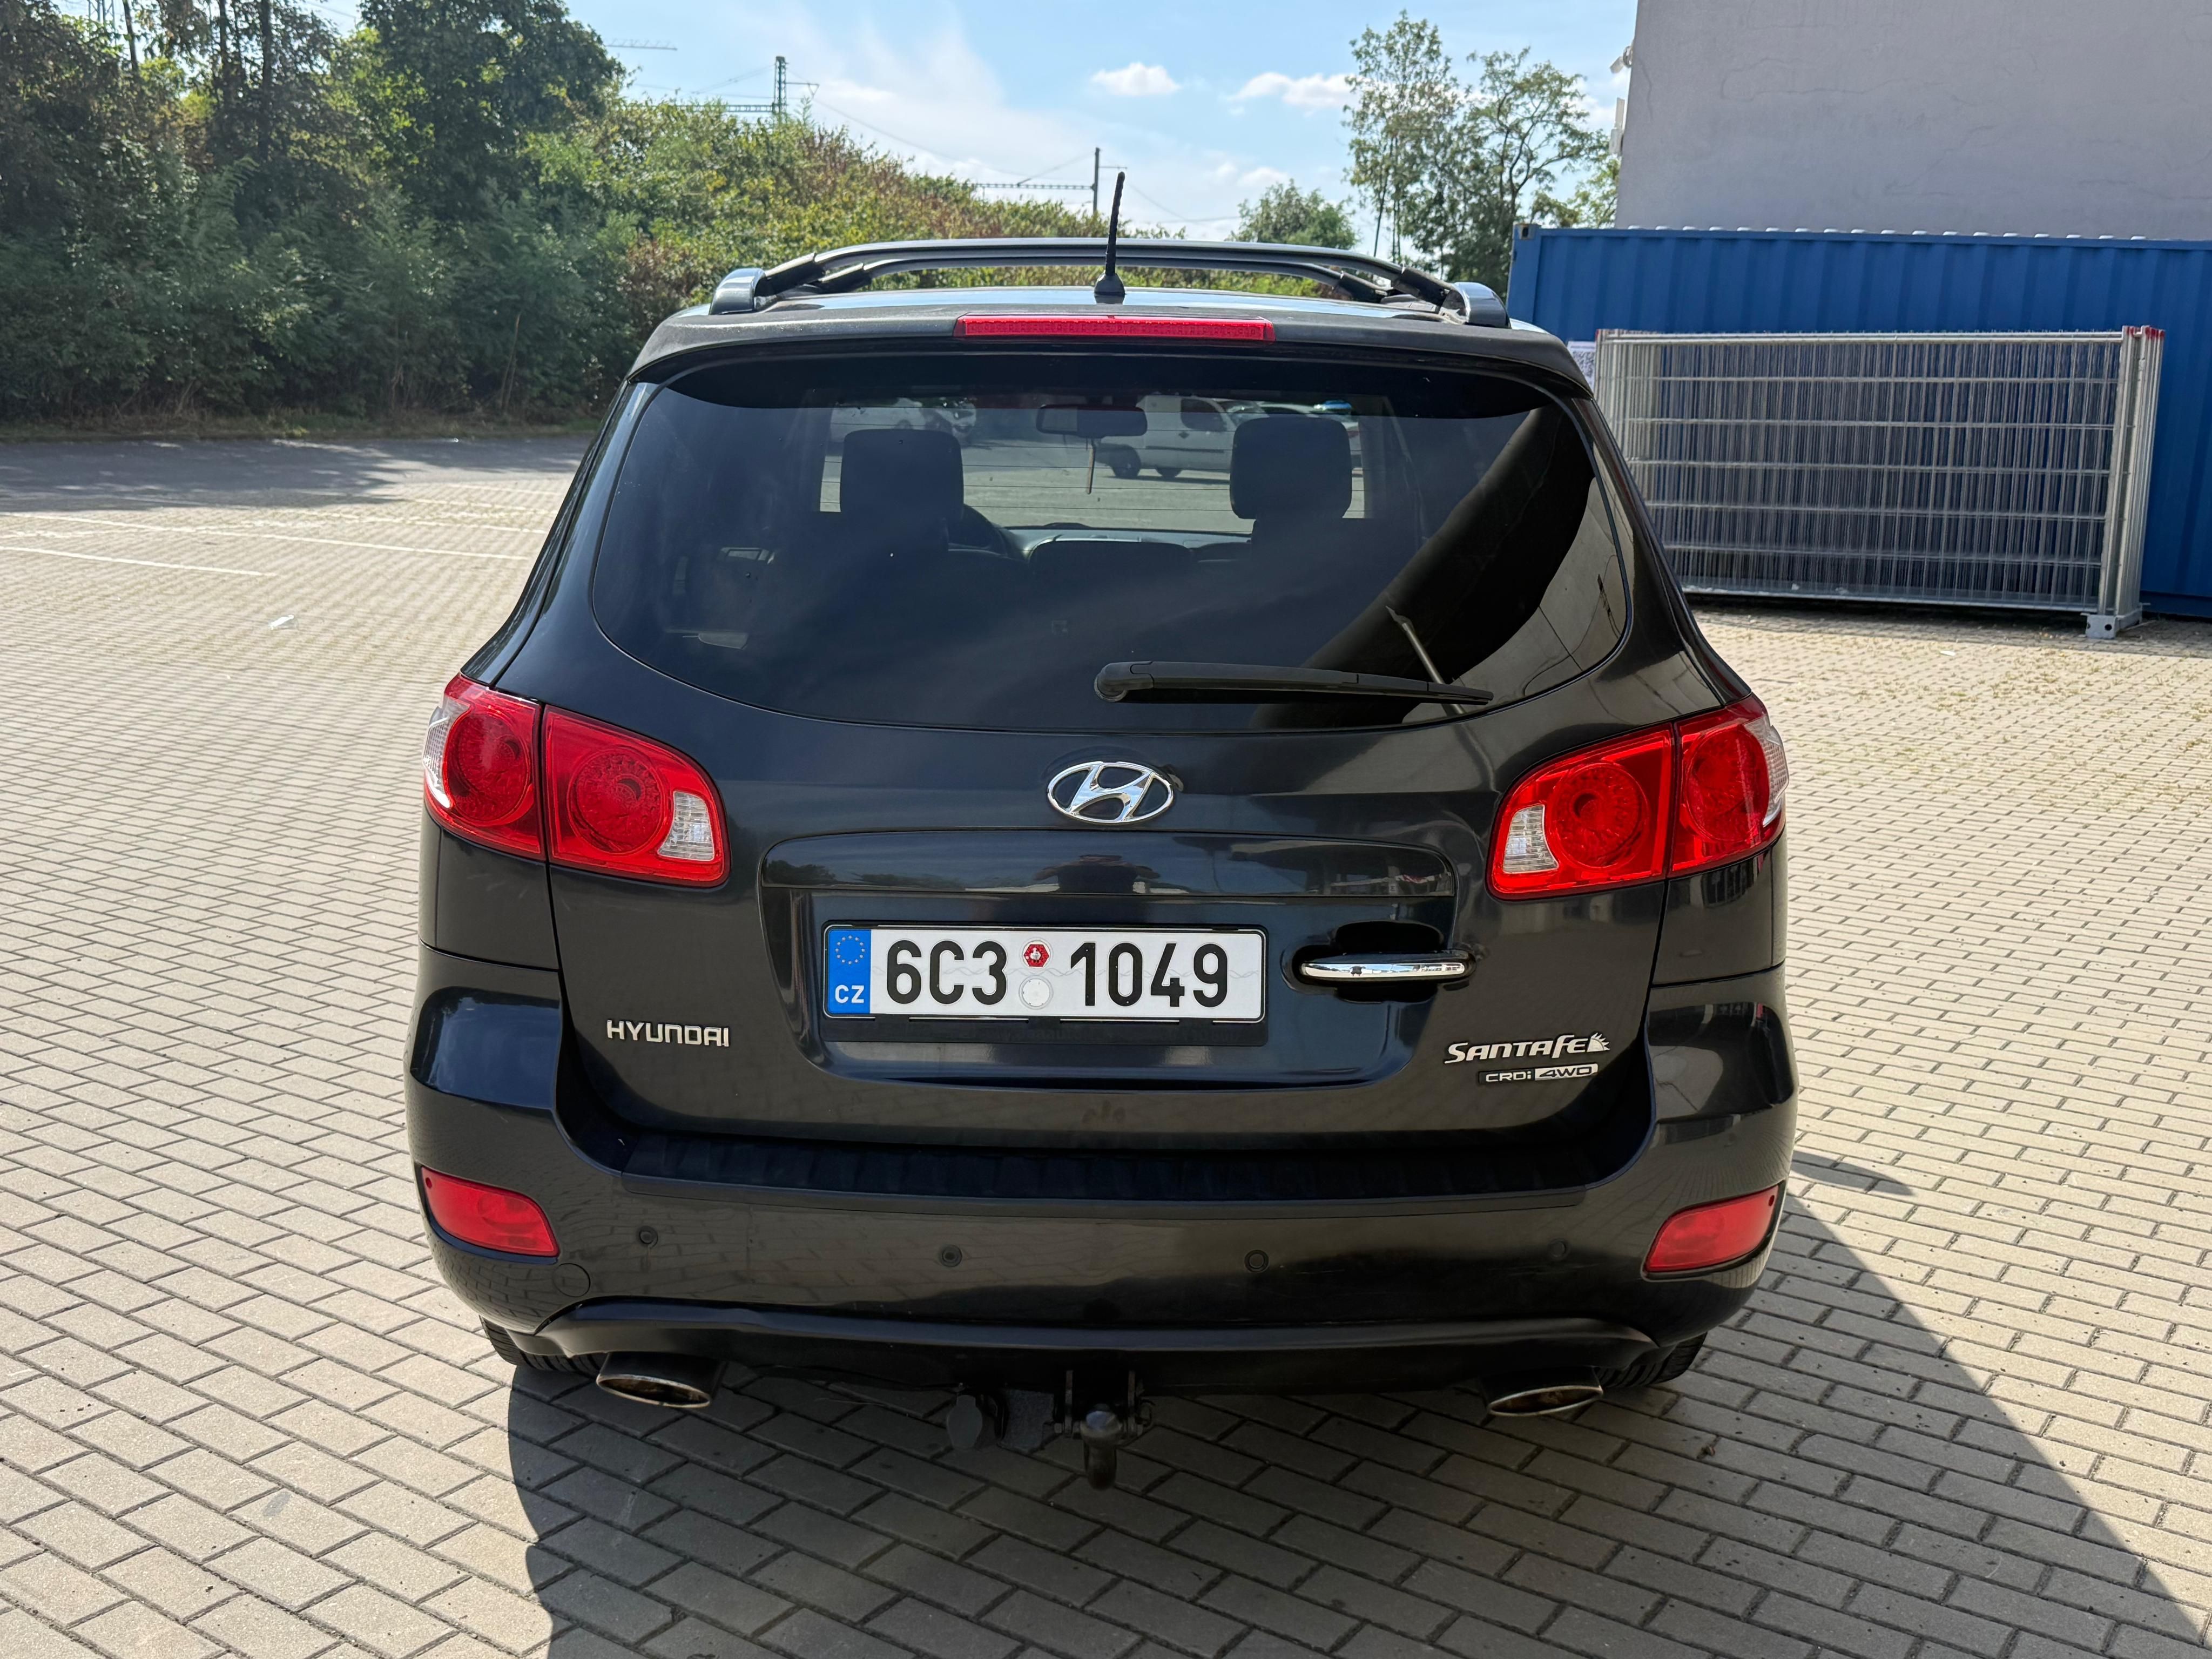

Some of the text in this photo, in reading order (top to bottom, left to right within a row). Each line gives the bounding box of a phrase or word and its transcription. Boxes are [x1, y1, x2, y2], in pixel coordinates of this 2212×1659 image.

[886, 940, 1228, 1008] 6C3 1049
[835, 984, 865, 1003] CZ
[606, 1020, 729, 1047] HYUNDAI
[1486, 1065, 1593, 1082] CRDi 4WD
